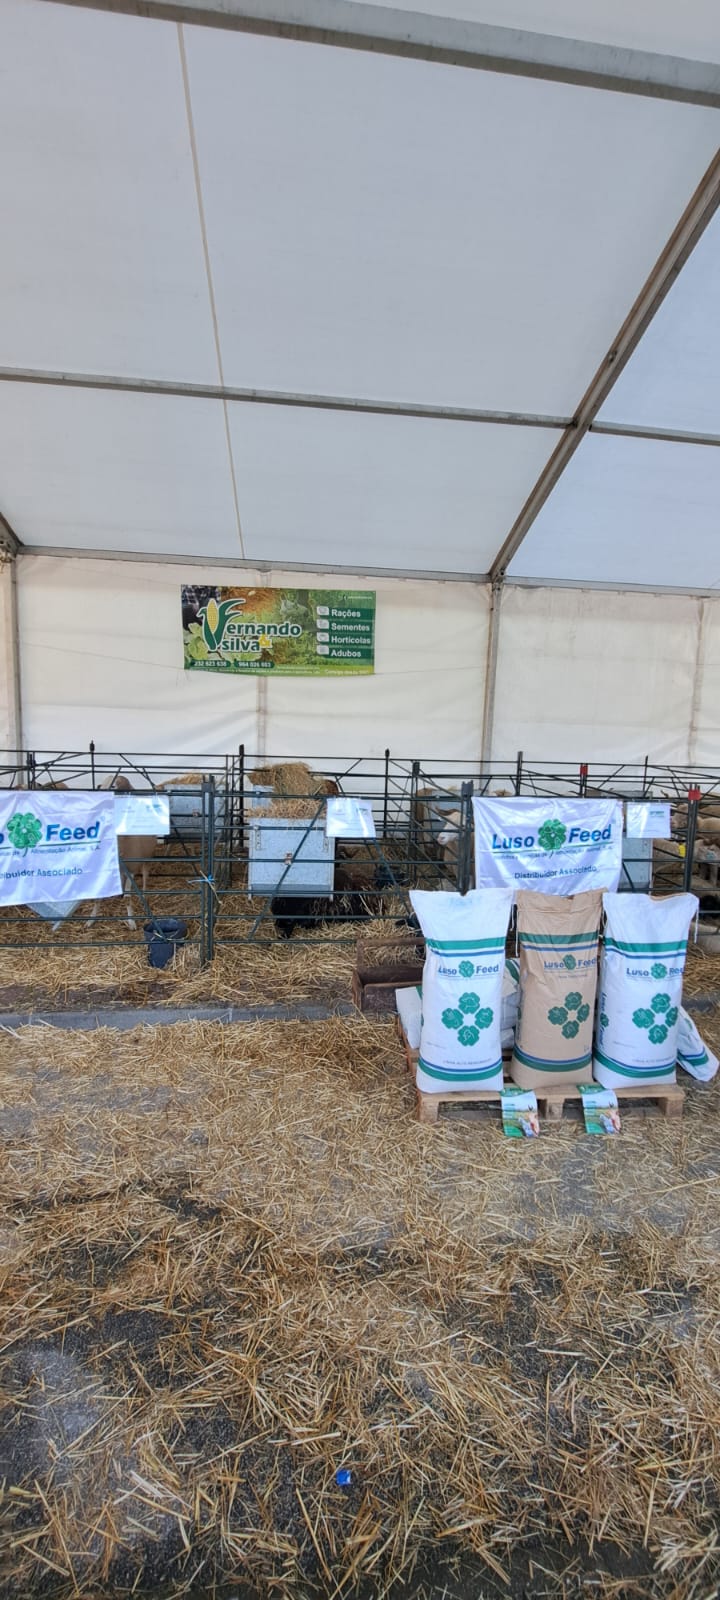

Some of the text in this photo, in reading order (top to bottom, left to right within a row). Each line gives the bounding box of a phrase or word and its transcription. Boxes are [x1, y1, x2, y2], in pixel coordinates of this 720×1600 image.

[331, 609, 361, 618] Rações
[331, 623, 370, 632] Sementes
[222, 638, 260, 651] silva
[331, 649, 361, 658] Adubos
[45, 821, 100, 841] Feed
[491, 824, 612, 850] Luso Feed
[36, 867, 83, 877] Associado
[514, 865, 597, 880] Distribuidor Associado
[438, 964, 499, 976] Luso Feed
[543, 961, 564, 969] Luso
[626, 967, 649, 977] Luso
